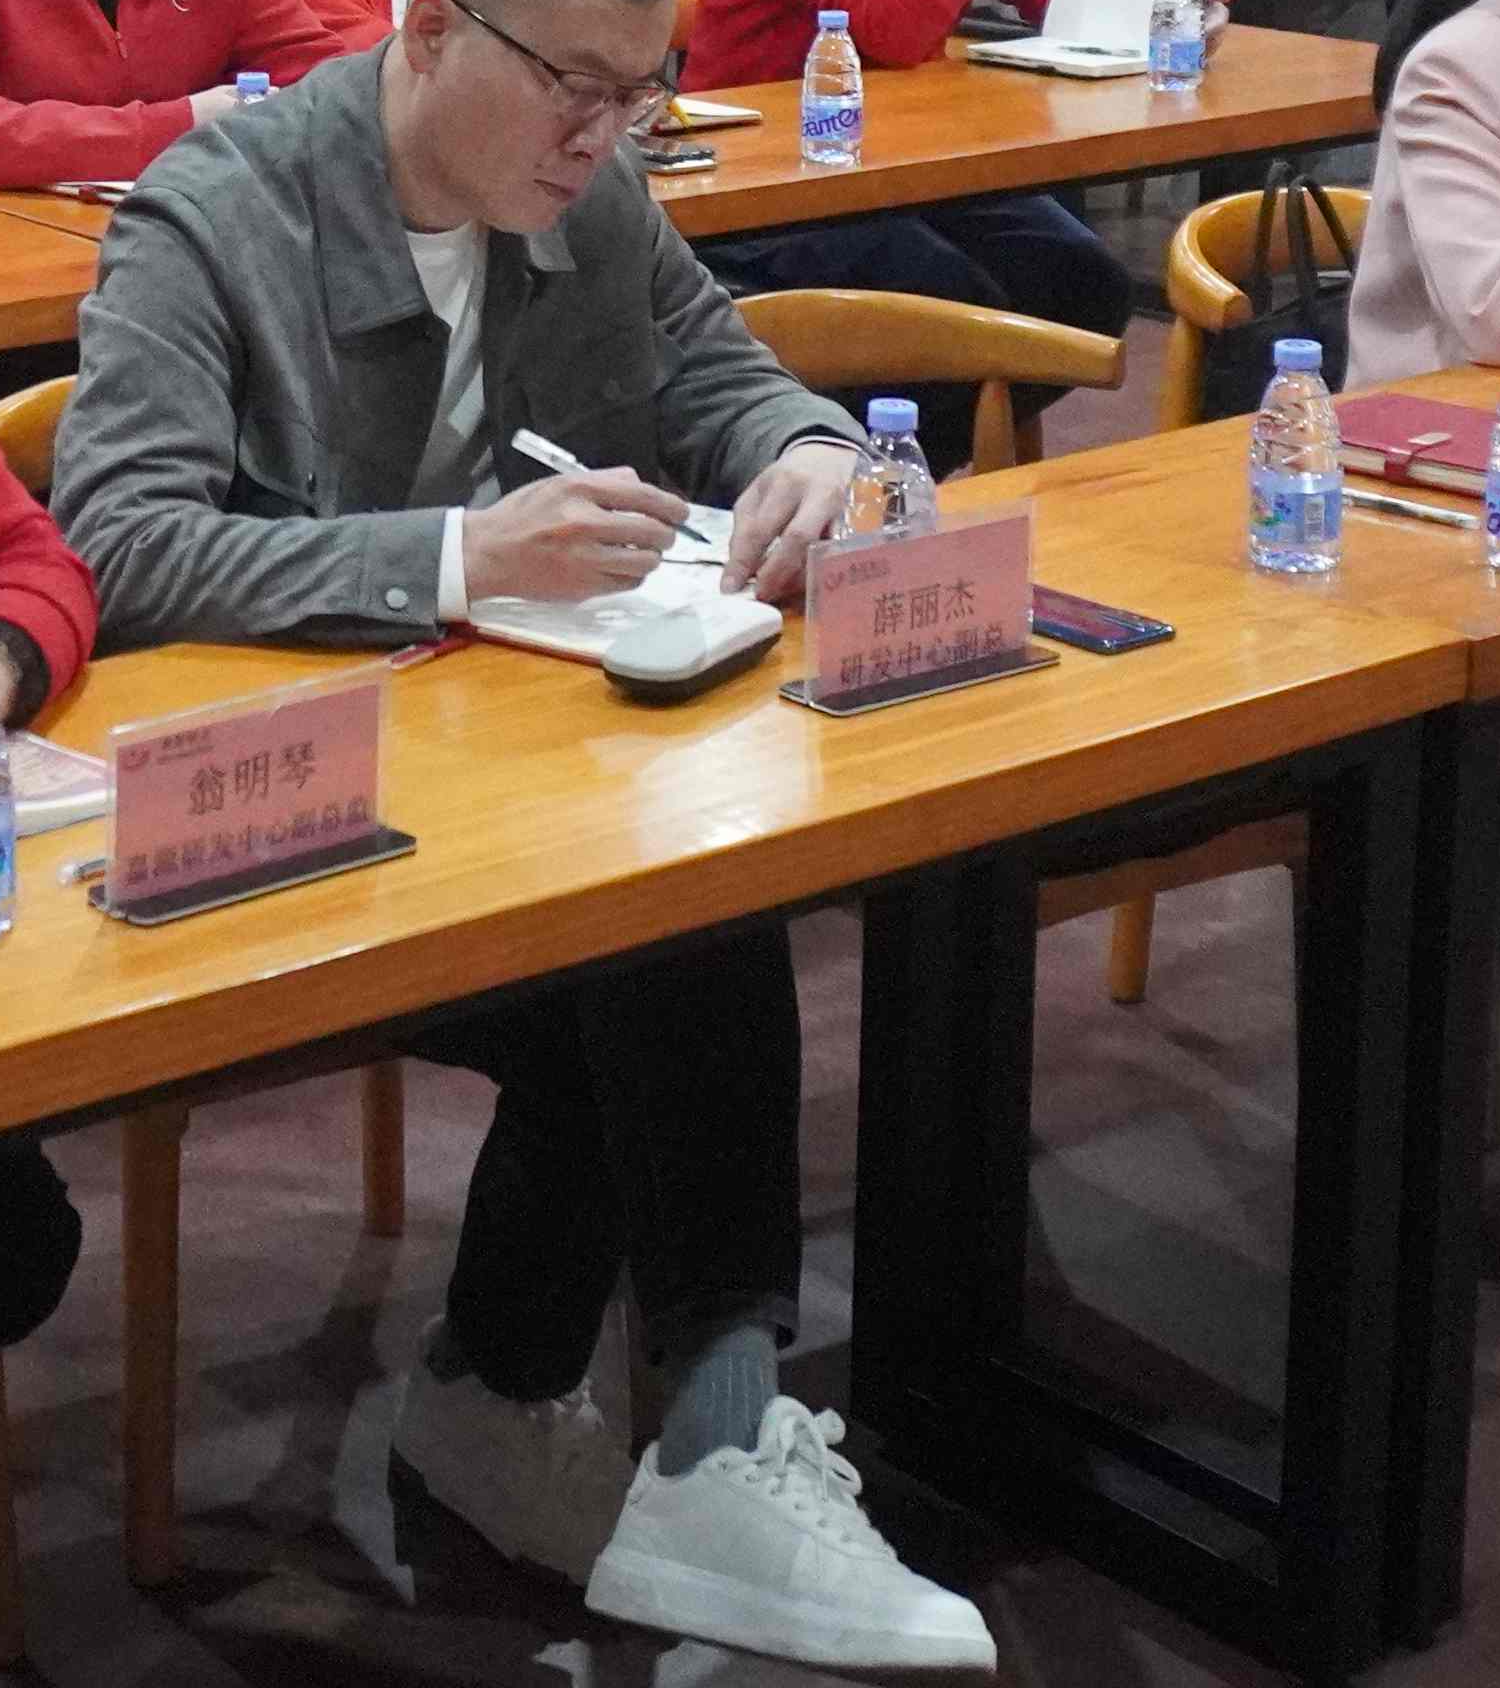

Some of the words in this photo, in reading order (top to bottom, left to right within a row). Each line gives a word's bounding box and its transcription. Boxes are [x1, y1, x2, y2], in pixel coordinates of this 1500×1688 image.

[872, 577, 976, 639] 薛丽杰
[188, 740, 316, 816] 翁明琴
